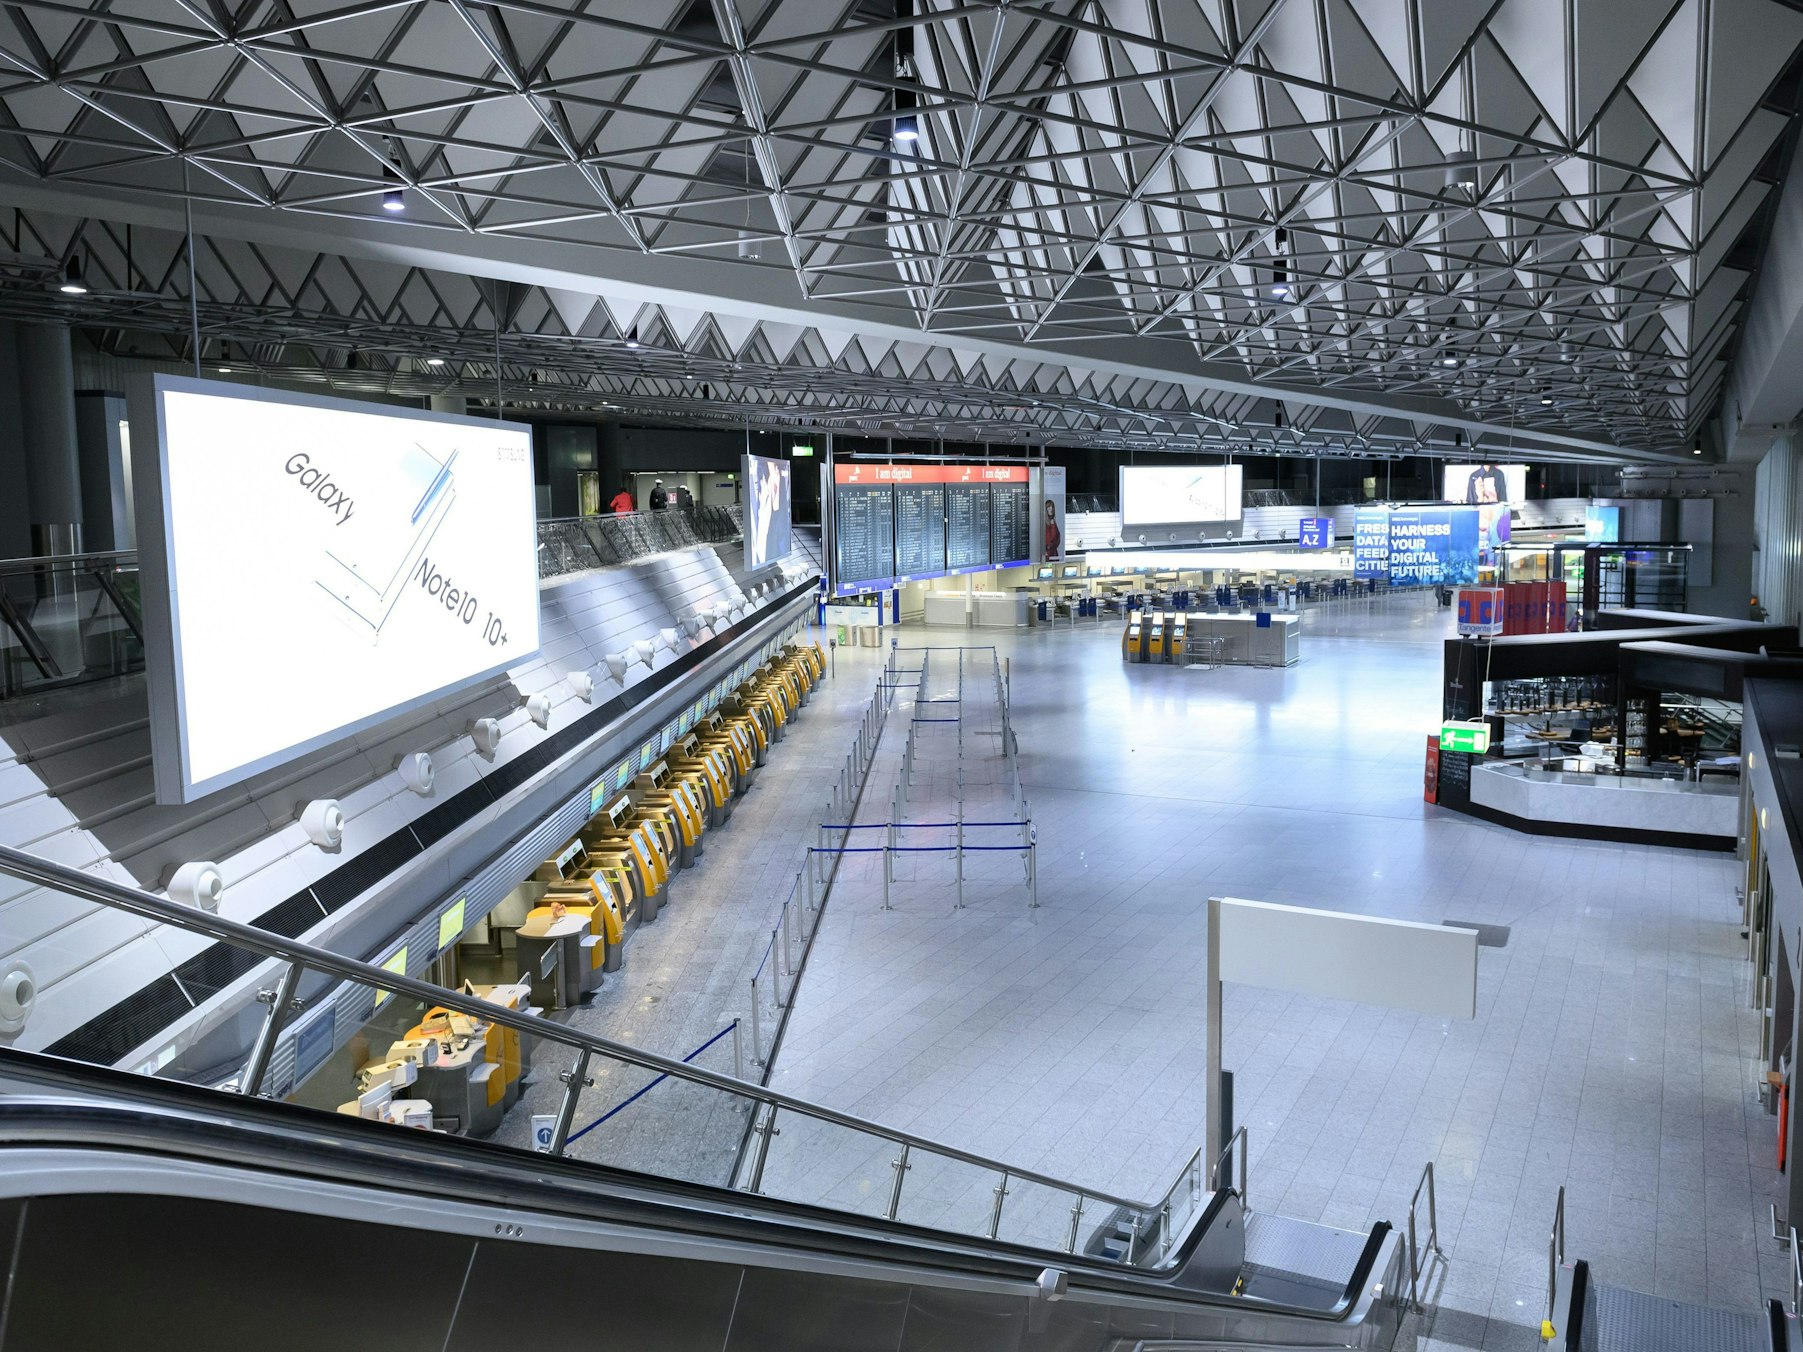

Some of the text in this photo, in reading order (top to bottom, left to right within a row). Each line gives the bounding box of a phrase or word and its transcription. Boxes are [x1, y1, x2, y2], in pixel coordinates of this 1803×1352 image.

[891, 467, 912, 482] digital
[985, 471, 994, 479] am
[994, 467, 1011, 481] digital
[284, 452, 355, 526] Galaxy
[1391, 524, 1450, 537] HARNESS
[1356, 535, 1389, 546] DATA
[1391, 539, 1426, 550] YOUR
[1391, 552, 1439, 564] DIGITAL
[1391, 565, 1444, 577] FUTURE.
[413, 557, 508, 646] Note10 10+
